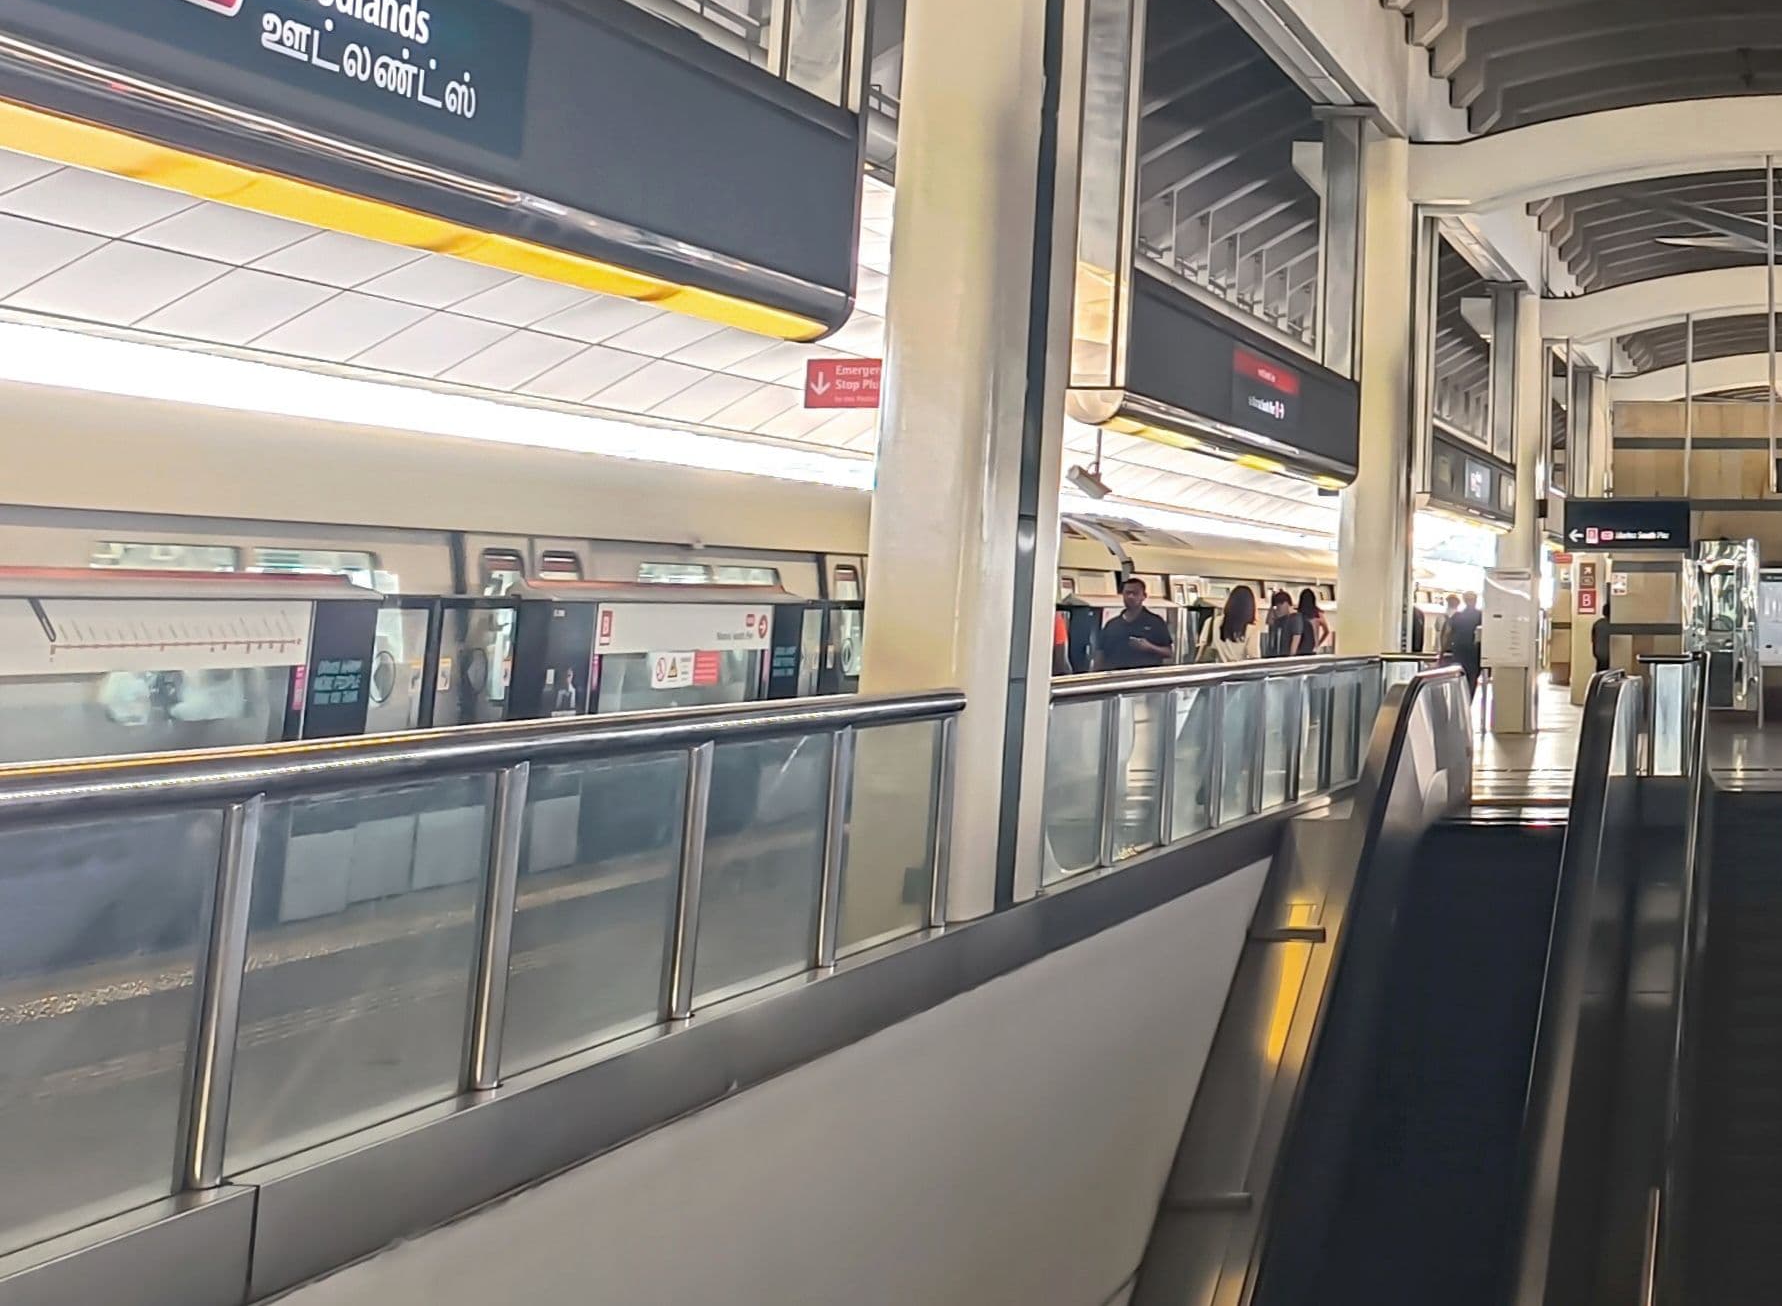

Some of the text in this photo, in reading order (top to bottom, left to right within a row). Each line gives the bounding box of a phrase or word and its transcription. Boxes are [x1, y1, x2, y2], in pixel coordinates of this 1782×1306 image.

[261, 12, 477, 119] ஊட்லண்ட்ஸ்
[835, 364, 881, 378] Emergen
[835, 379, 880, 392] Stop Plu
[1582, 593, 1592, 607] B
